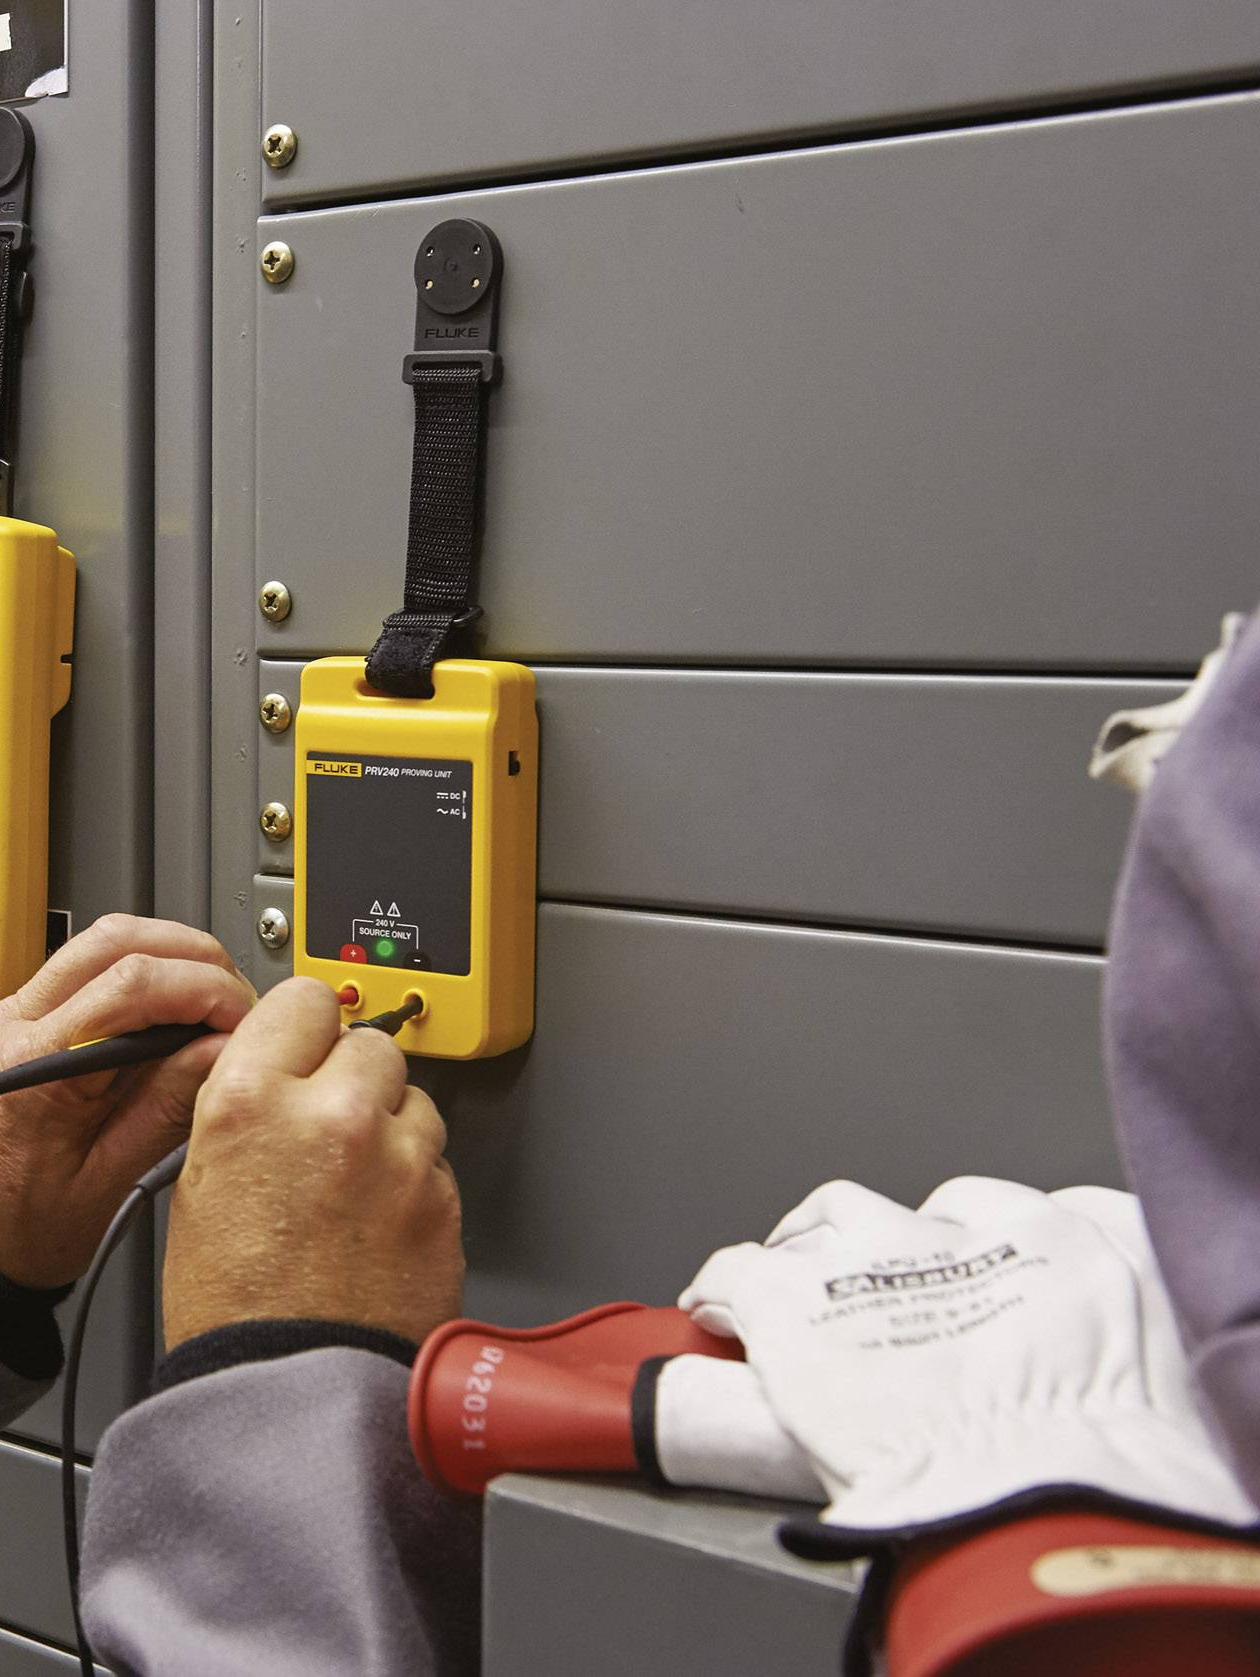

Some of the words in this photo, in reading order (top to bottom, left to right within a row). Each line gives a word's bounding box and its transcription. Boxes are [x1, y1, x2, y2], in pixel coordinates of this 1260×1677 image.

[424, 327, 480, 339] FLUKE
[314, 763, 358, 774] FLUKE
[364, 766, 400, 777] PRV240
[400, 768, 433, 778] PROVING
[434, 770, 453, 779] UNIT
[450, 792, 461, 800] DC
[450, 808, 461, 816] AC
[375, 918, 388, 927] 240
[389, 920, 395, 928] V
[359, 927, 390, 938] SOURCE
[391, 931, 412, 940] ONLY
